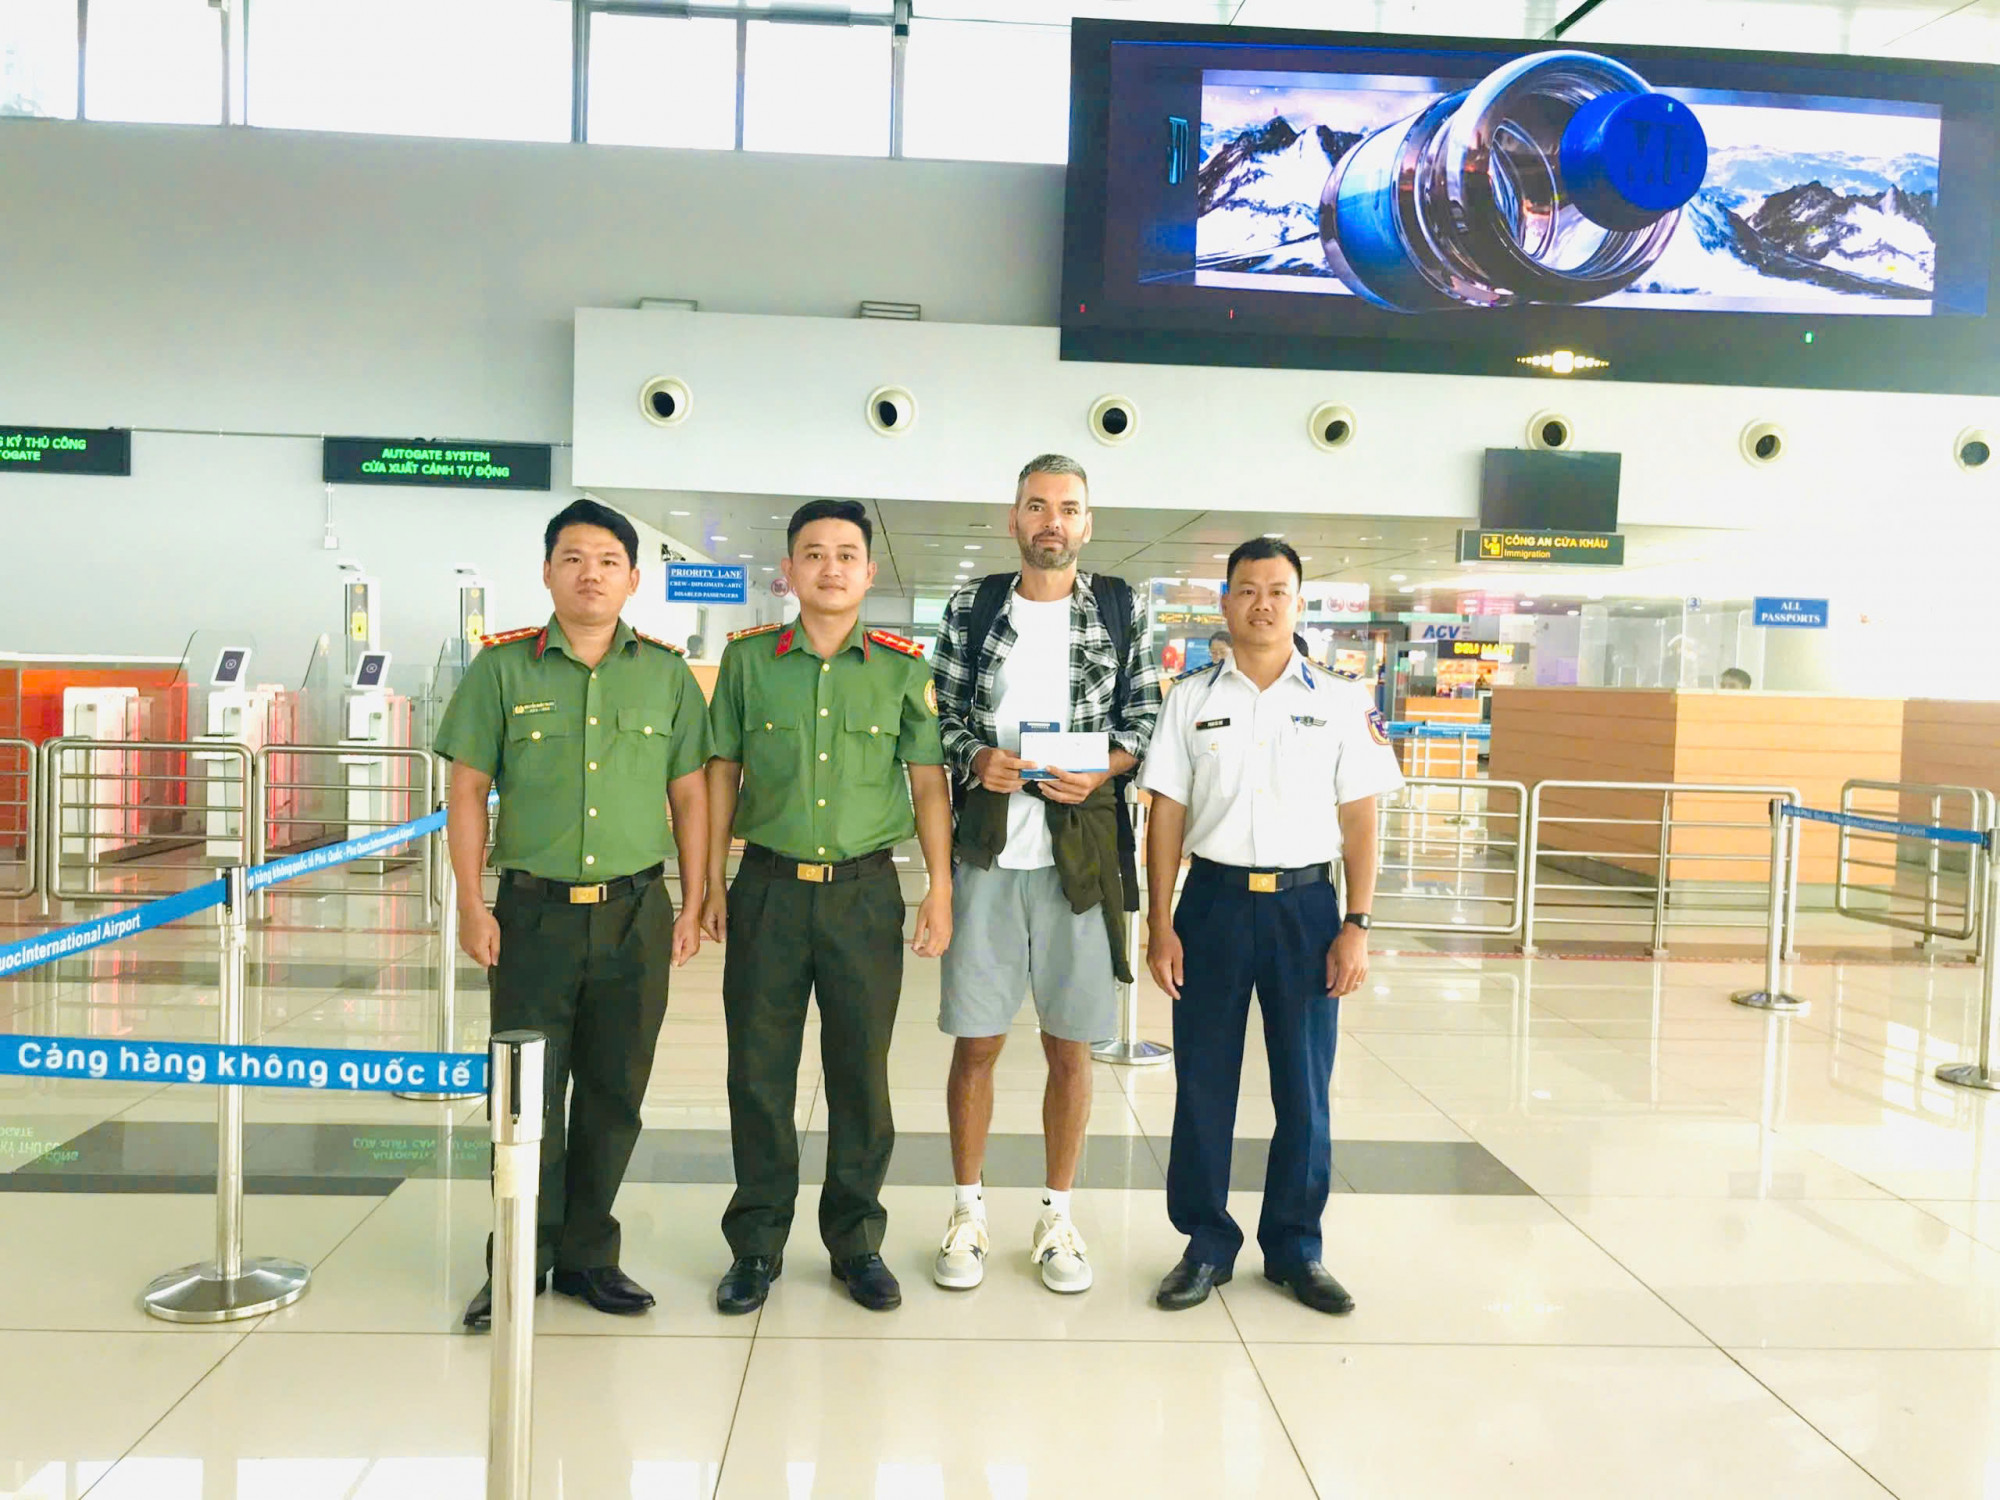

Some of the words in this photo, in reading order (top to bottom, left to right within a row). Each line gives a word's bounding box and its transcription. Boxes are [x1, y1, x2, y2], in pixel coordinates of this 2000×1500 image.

[6, 434, 22, 447] KÝ
[52, 435, 87, 450] CÔNG
[382, 448, 443, 461] AUTOGATE
[445, 450, 490, 462] SYSTEM
[1504, 534, 1536, 546] CÔNG
[1537, 538, 1552, 547] AN
[1504, 549, 1551, 559] Immigration
[671, 569, 714, 577] PRIORITY
[718, 571, 742, 579] LANE
[1781, 602, 1802, 611] ALL
[1761, 613, 1820, 623] PASSPORTS
[1423, 625, 1460, 639] ACV
[22, 924, 101, 962] International
[102, 913, 140, 939] Airport
[18, 1042, 108, 1078] Cảng
[120, 1046, 206, 1082] hàng
[218, 1051, 328, 1088] không
[339, 1057, 425, 1088] quốc
[438, 1059, 472, 1087] tế
